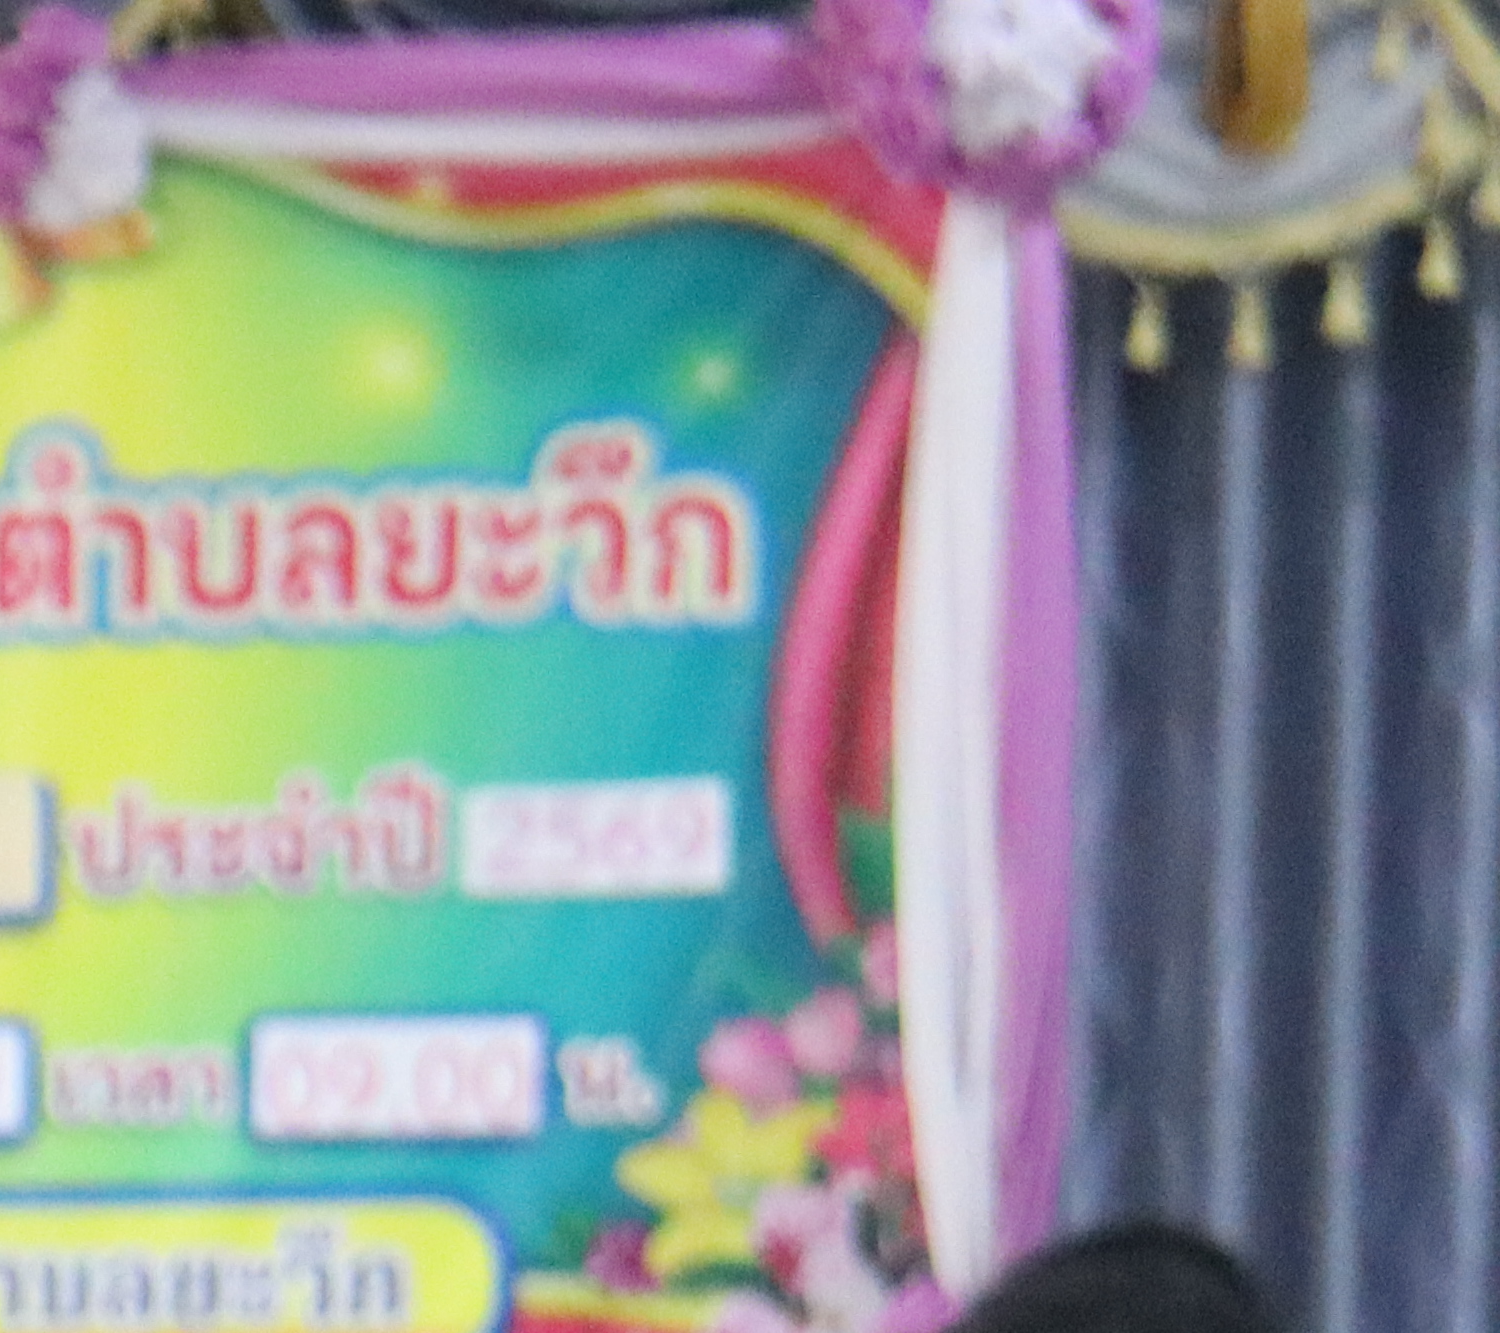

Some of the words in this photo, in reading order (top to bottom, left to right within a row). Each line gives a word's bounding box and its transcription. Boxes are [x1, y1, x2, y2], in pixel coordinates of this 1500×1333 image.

[76, 768, 438, 894] ประจำปี
[484, 790, 712, 878] 2569
[264, 1038, 528, 1128] 09.00
